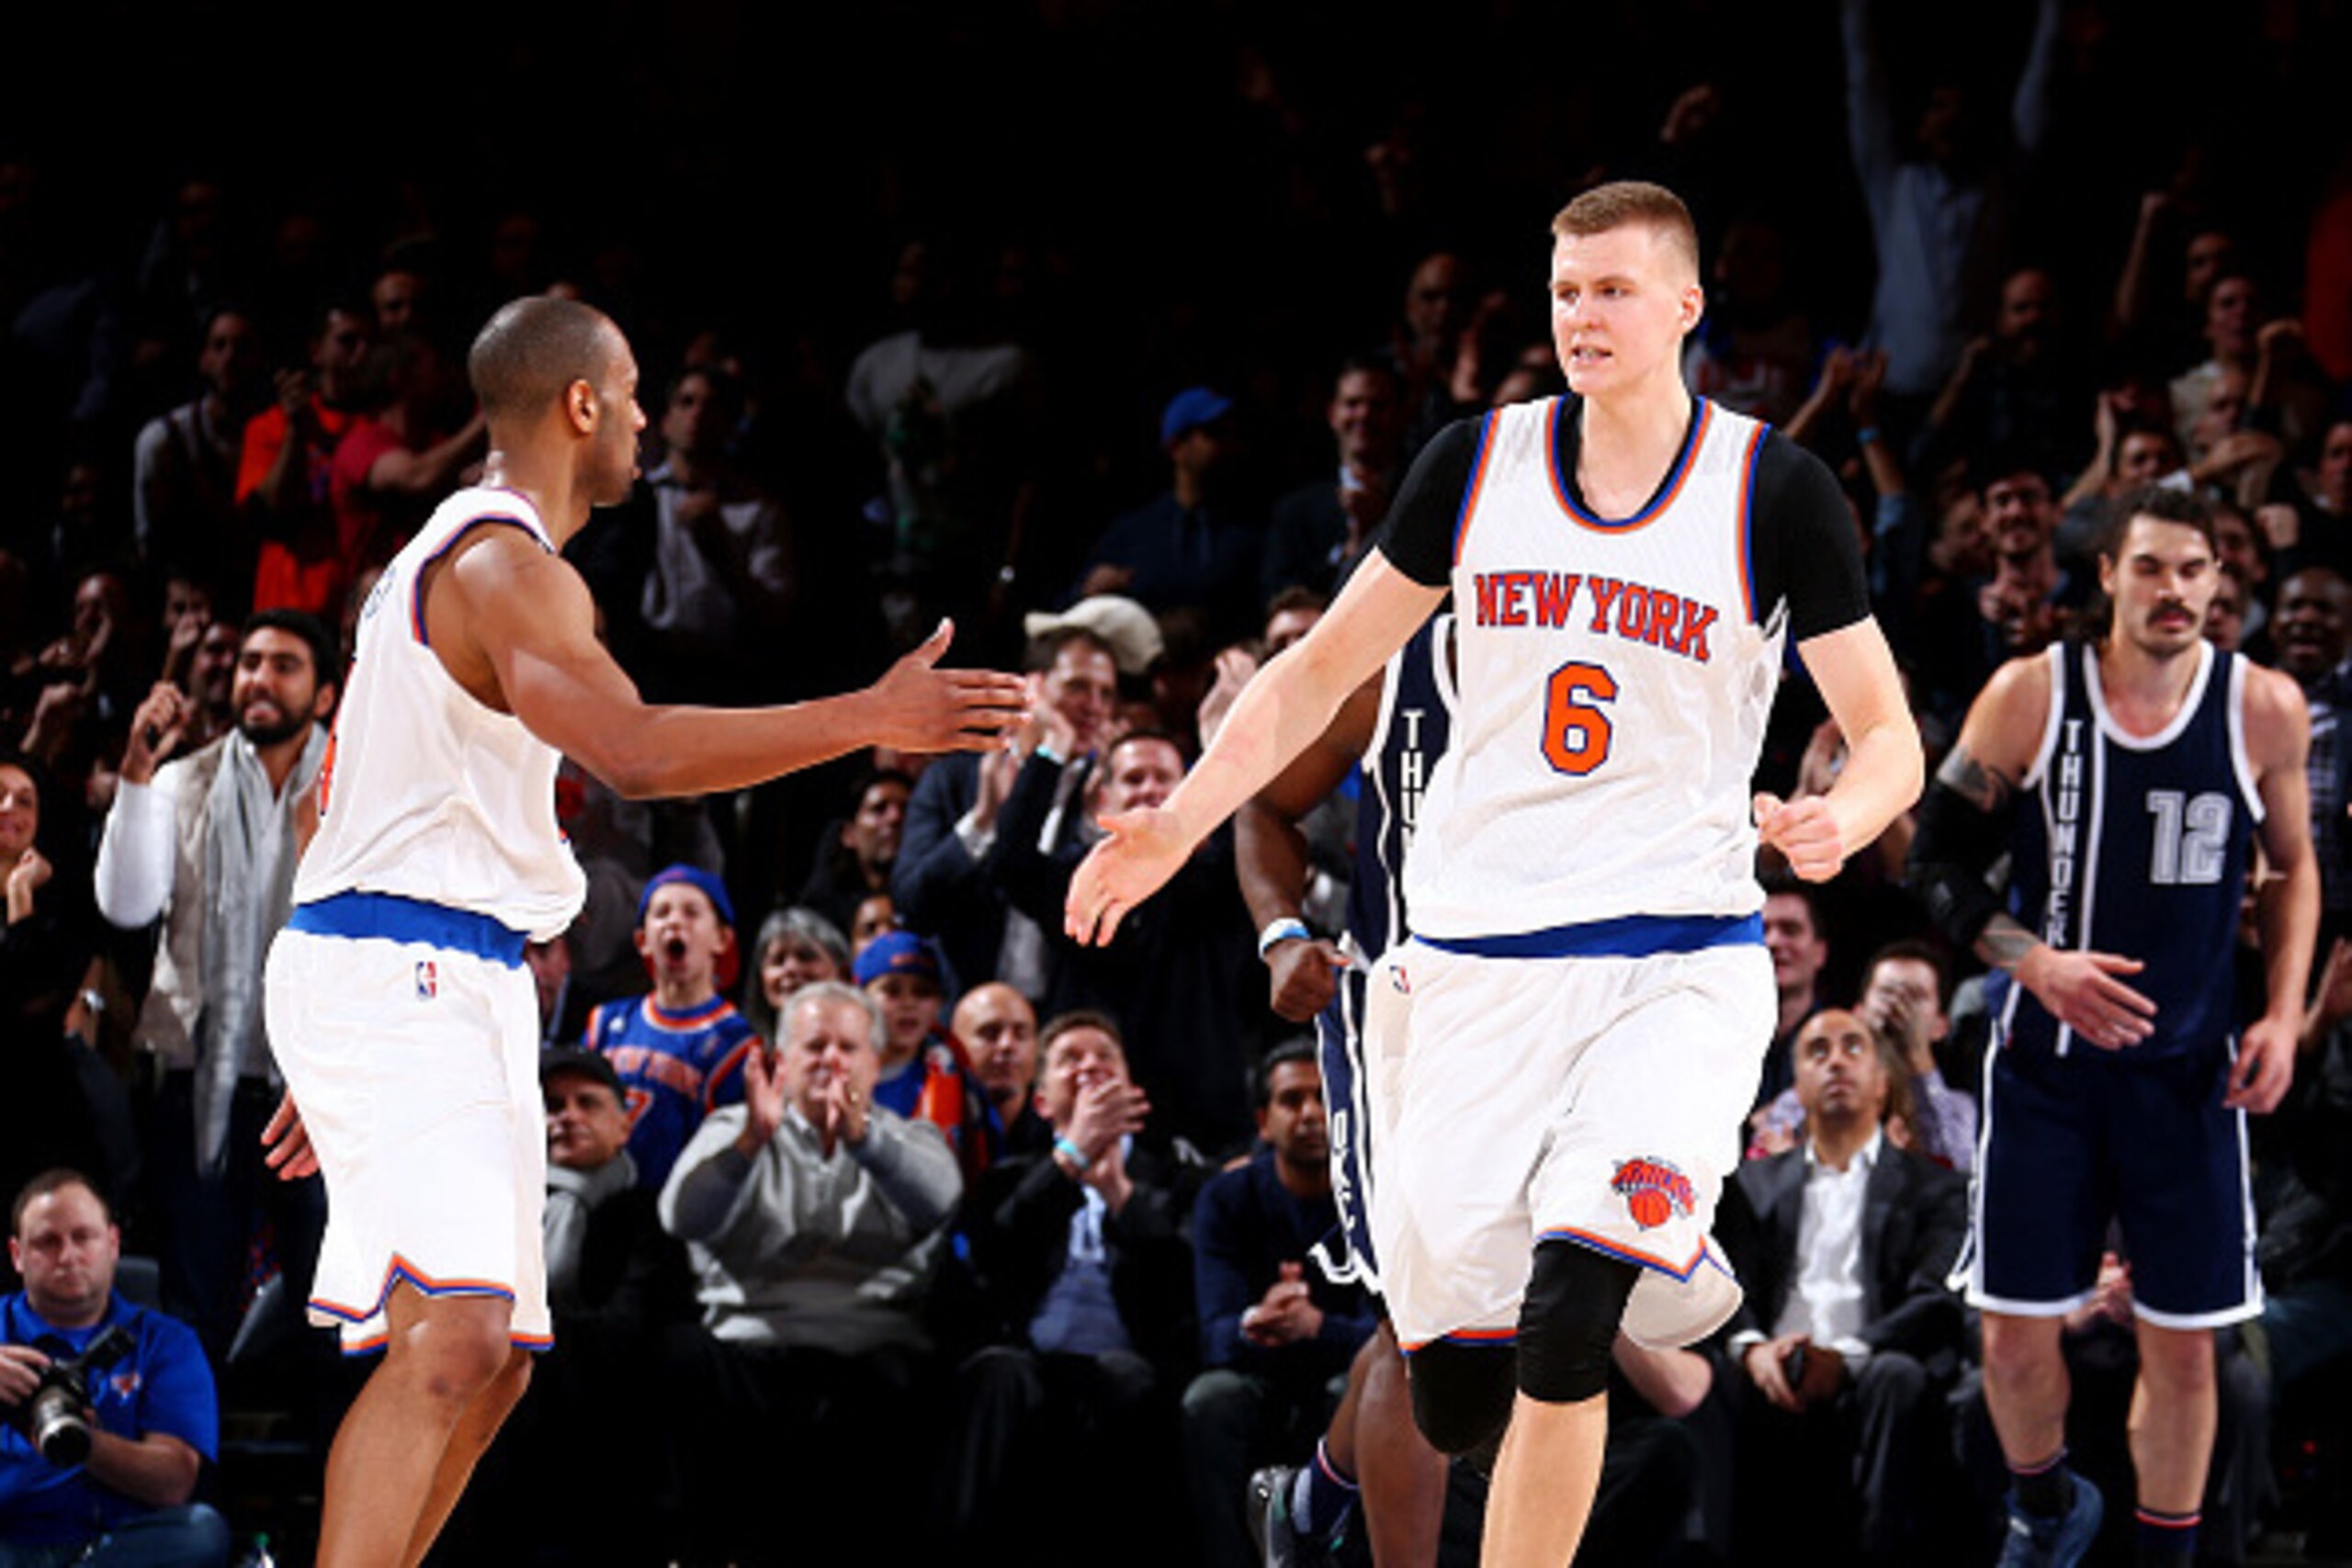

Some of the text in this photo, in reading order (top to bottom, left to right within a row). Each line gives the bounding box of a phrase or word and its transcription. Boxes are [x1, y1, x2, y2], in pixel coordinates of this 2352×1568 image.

[1474, 570, 1719, 663] NEW YORK
[1540, 660, 1620, 776] 6
[2046, 719, 2084, 948] THUNDER
[2145, 790, 2233, 885] 12
